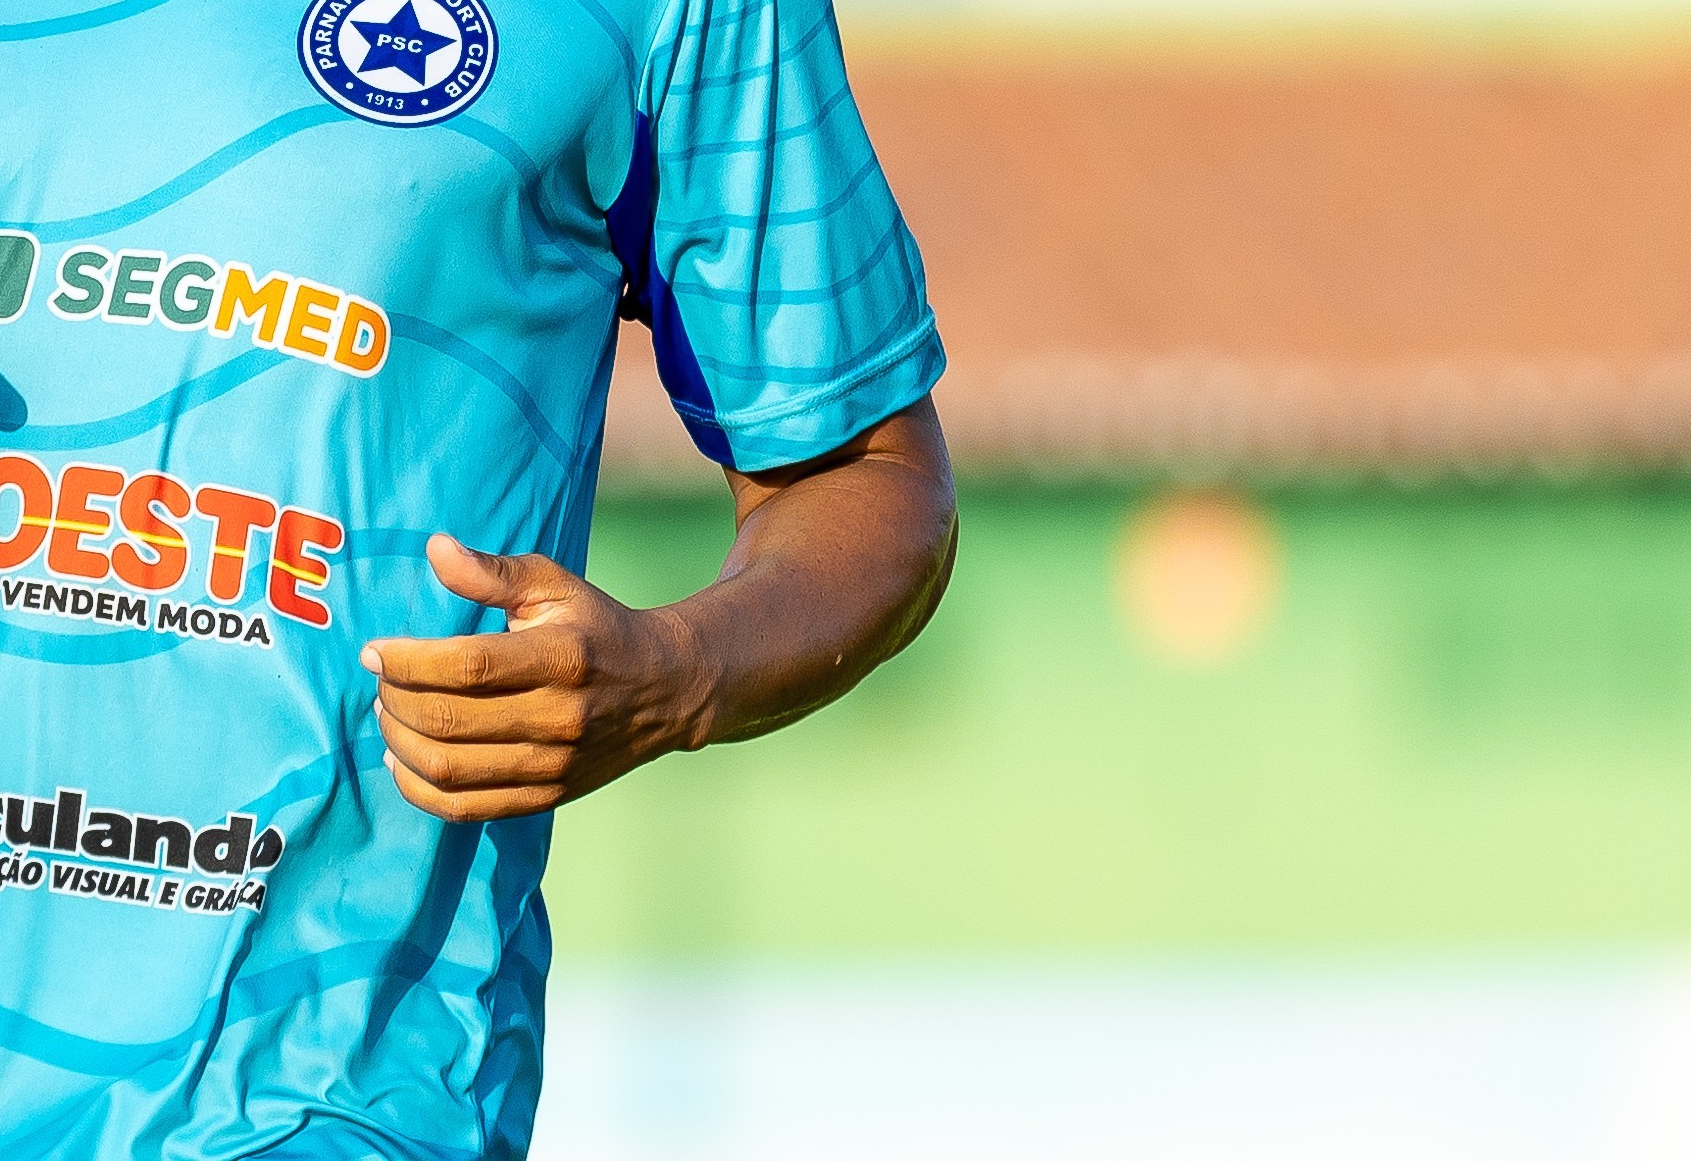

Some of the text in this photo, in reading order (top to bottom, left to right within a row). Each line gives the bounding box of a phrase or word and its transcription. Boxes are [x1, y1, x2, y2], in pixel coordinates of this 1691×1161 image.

[376, 33, 423, 54] PSC
[444, 42, 484, 99] CLUB
[366, 91, 405, 110] 1913
[52, 250, 391, 373] SEGMED
[2, 579, 148, 627] VENDEM
[157, 604, 271, 646] MODA
[52, 864, 151, 903] VISUAL
[158, 881, 180, 906] E
